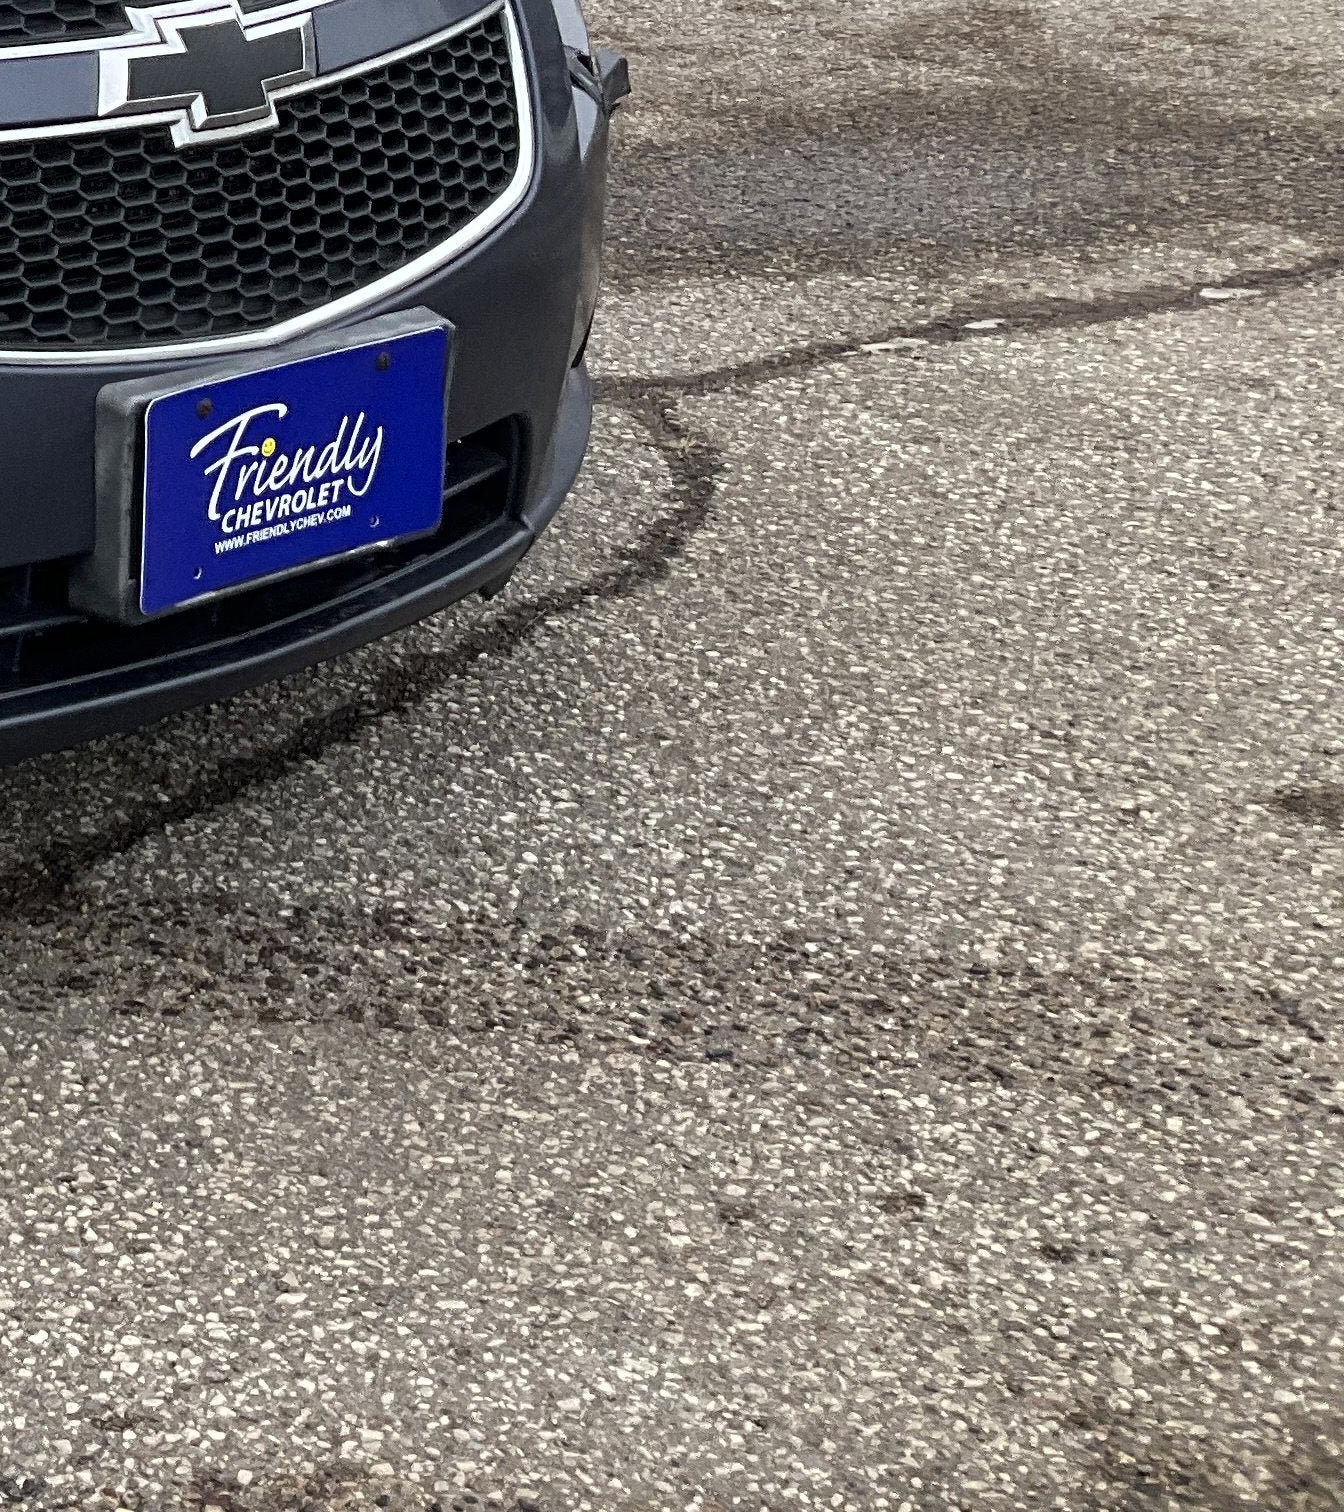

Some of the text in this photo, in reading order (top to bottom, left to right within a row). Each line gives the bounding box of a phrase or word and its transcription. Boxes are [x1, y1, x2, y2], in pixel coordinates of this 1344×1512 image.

[190, 403, 384, 521] Friendly
[214, 504, 352, 555] WWW.FRIENDLYCHEV.COM
[221, 478, 345, 534] CHEVROLET
